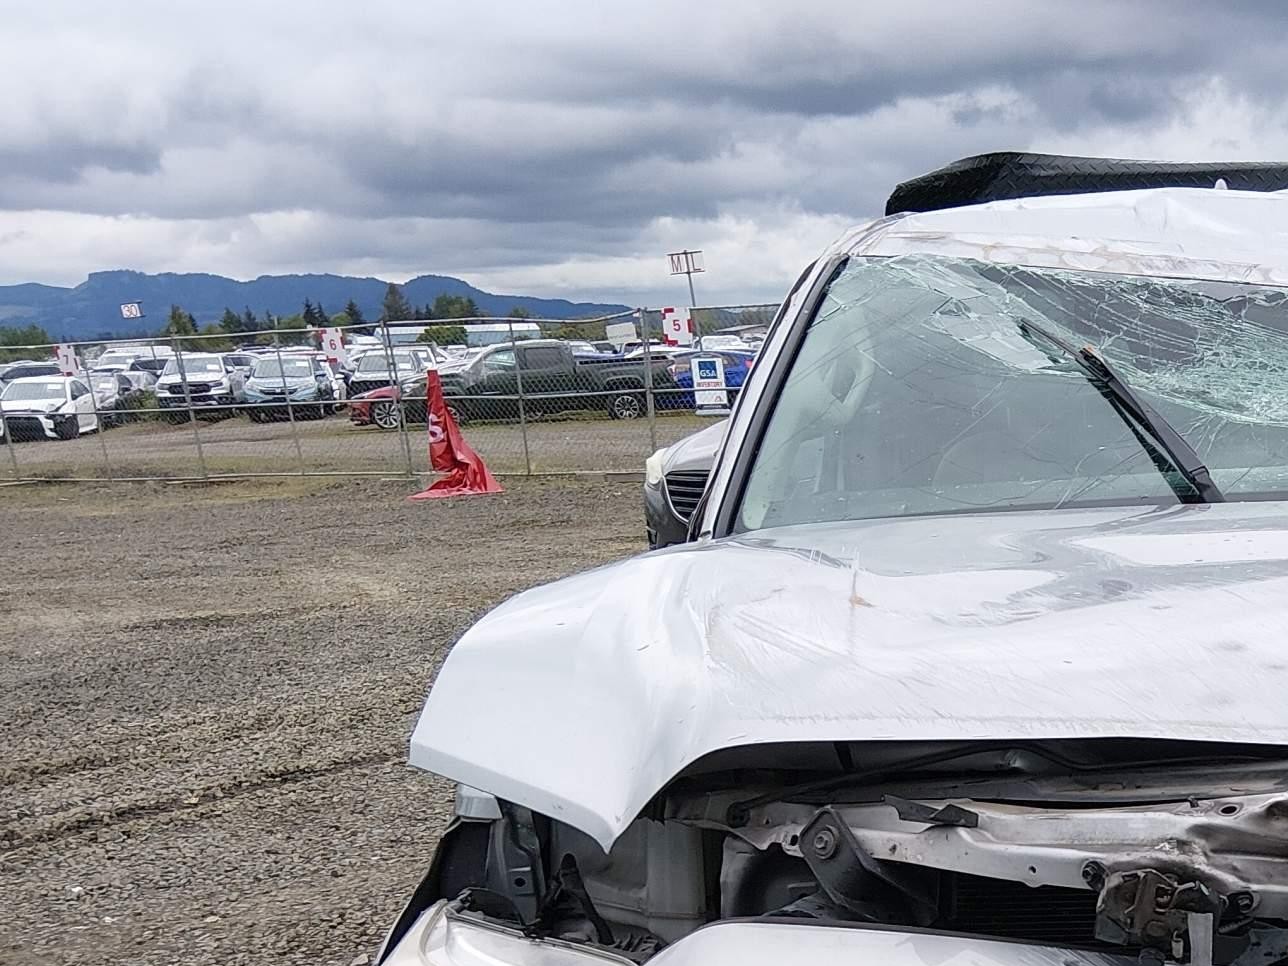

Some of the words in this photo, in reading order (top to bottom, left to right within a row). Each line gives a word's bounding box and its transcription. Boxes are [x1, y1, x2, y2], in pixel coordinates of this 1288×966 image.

[671, 255, 682, 273] M
[122, 304, 138, 318] 30
[672, 319, 681, 331] 5
[329, 339, 337, 351] 6
[63, 354, 69, 365] 7
[700, 369, 717, 378] GSA
